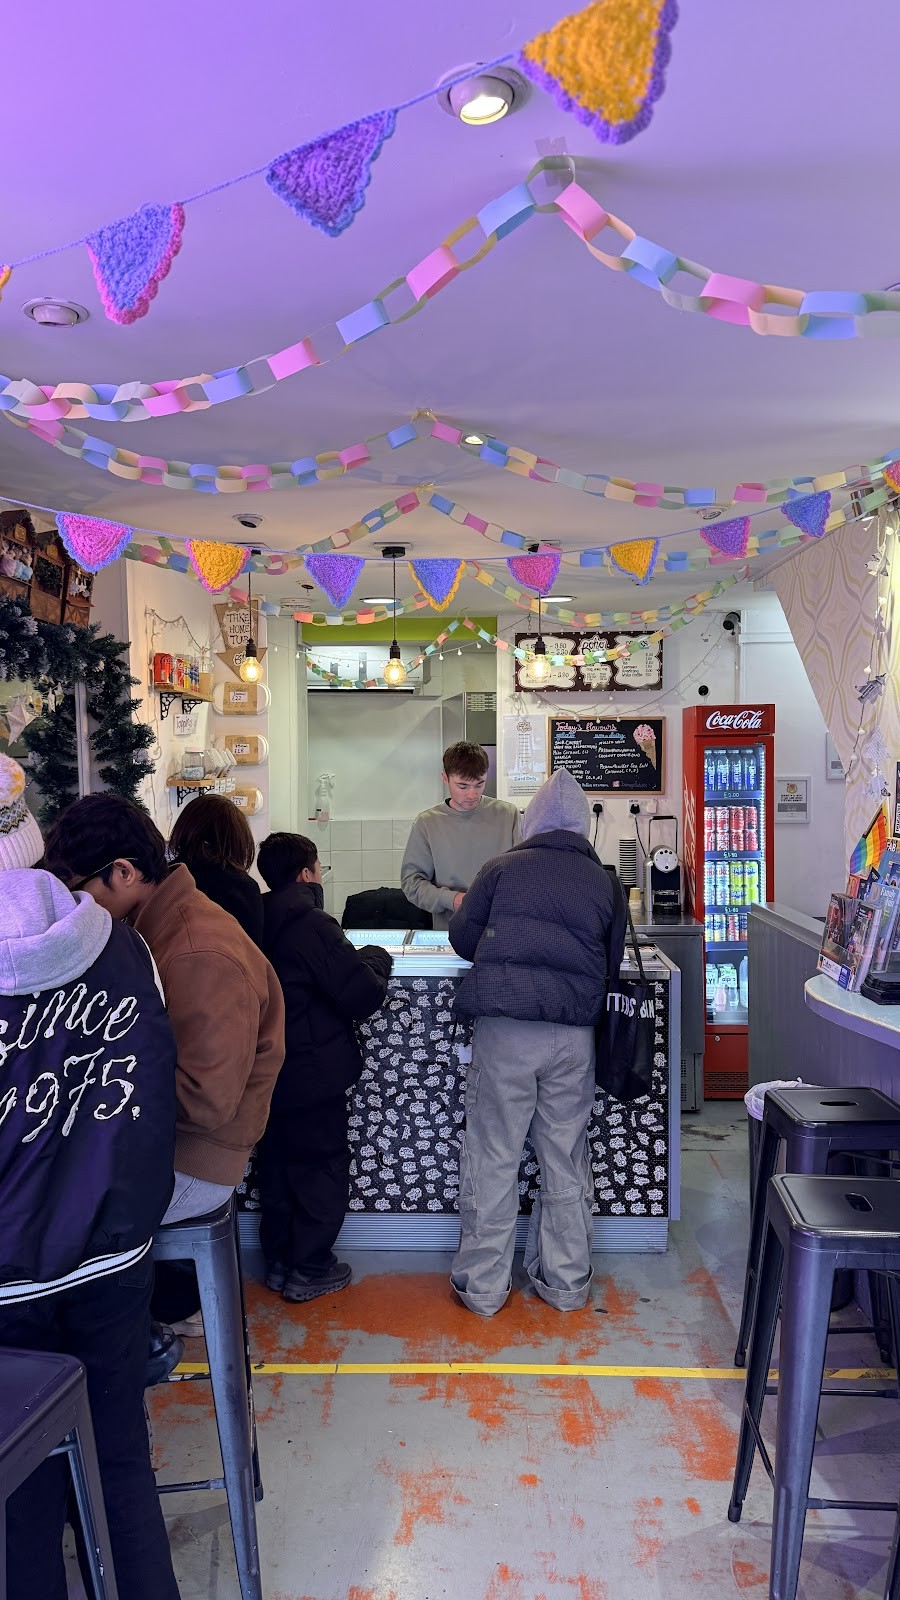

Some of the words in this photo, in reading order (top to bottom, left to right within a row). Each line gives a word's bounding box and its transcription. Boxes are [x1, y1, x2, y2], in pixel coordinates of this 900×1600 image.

[227, 612, 250, 624] TAKE
[229, 625, 250, 634] HOME
[556, 722, 583, 734] Today's
[586, 722, 617, 732] flavours
